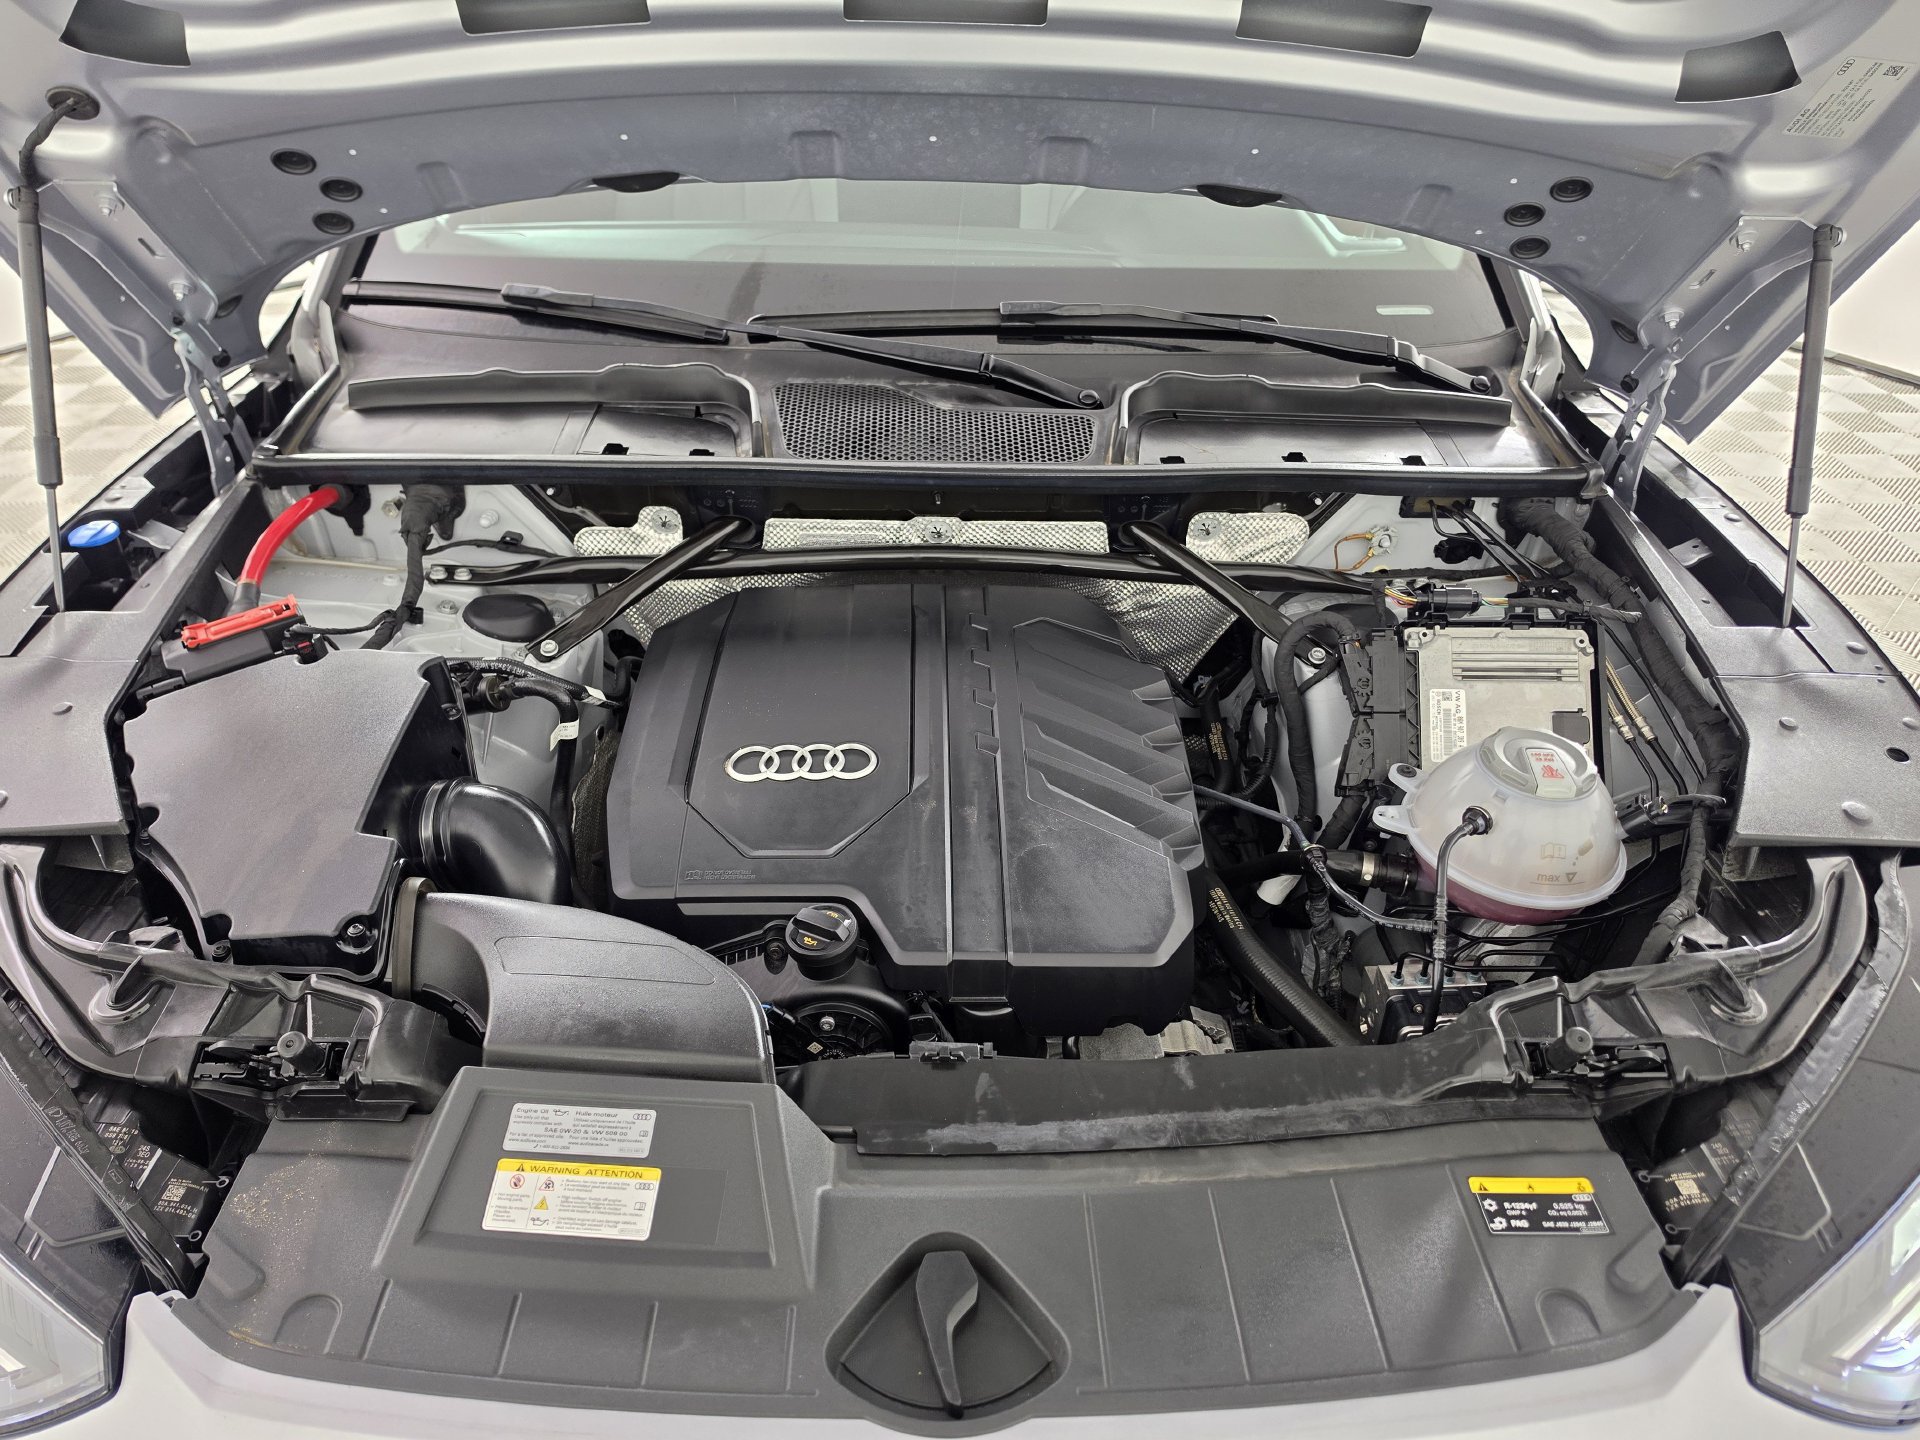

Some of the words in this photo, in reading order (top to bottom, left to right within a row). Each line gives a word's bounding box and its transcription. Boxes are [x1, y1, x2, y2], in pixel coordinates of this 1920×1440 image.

[1455, 691, 1461, 702] VW
[1455, 703, 1461, 714] AG
[1537, 874, 1560, 883] max
[530, 1165, 580, 1175] WARNING
[585, 1169, 643, 1178] ATTENTION
[1504, 1202, 1537, 1210] R-1234yf
[1510, 1219, 1529, 1228] PAG
